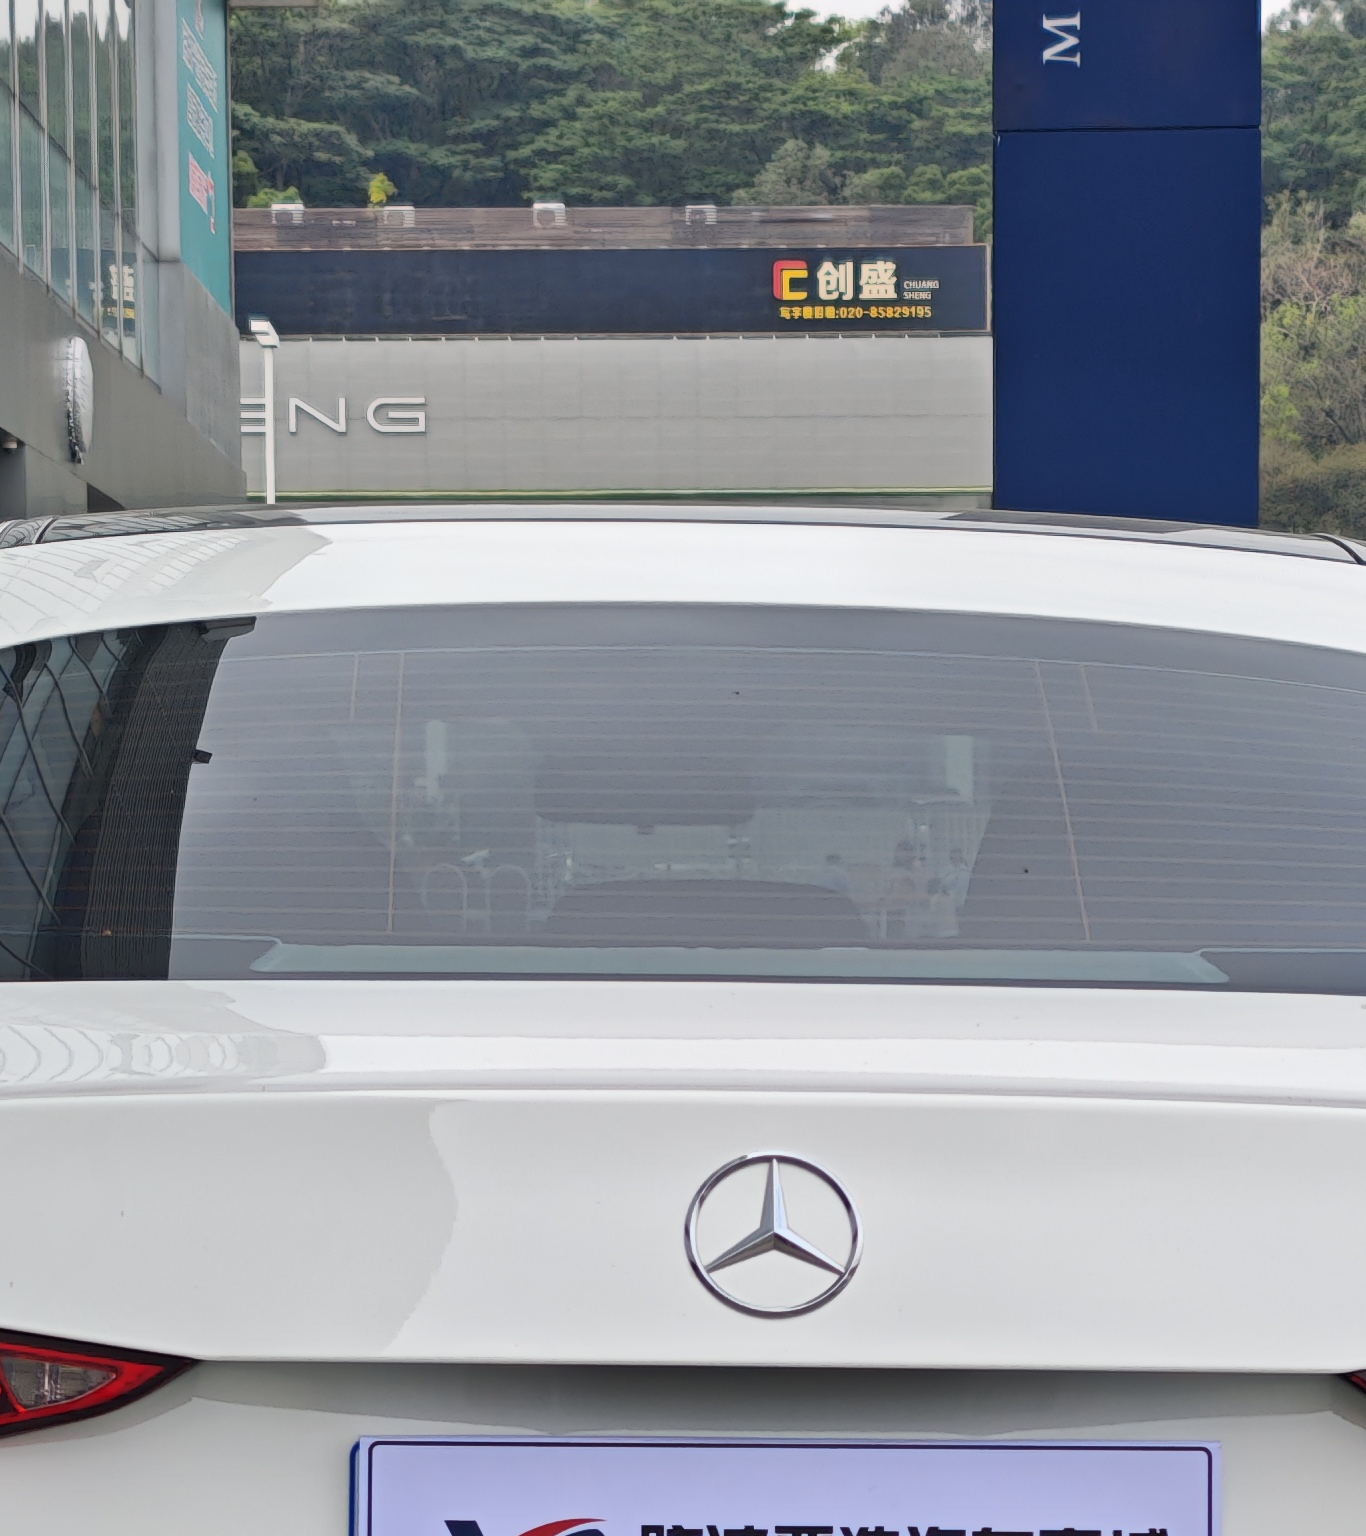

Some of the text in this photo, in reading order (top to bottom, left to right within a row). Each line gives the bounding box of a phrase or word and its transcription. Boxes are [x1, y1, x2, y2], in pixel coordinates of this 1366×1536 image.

[1042, 11, 1081, 68] M
[816, 260, 898, 301] 创盛
[903, 280, 940, 289] CHUANG
[903, 291, 932, 300] SHENG
